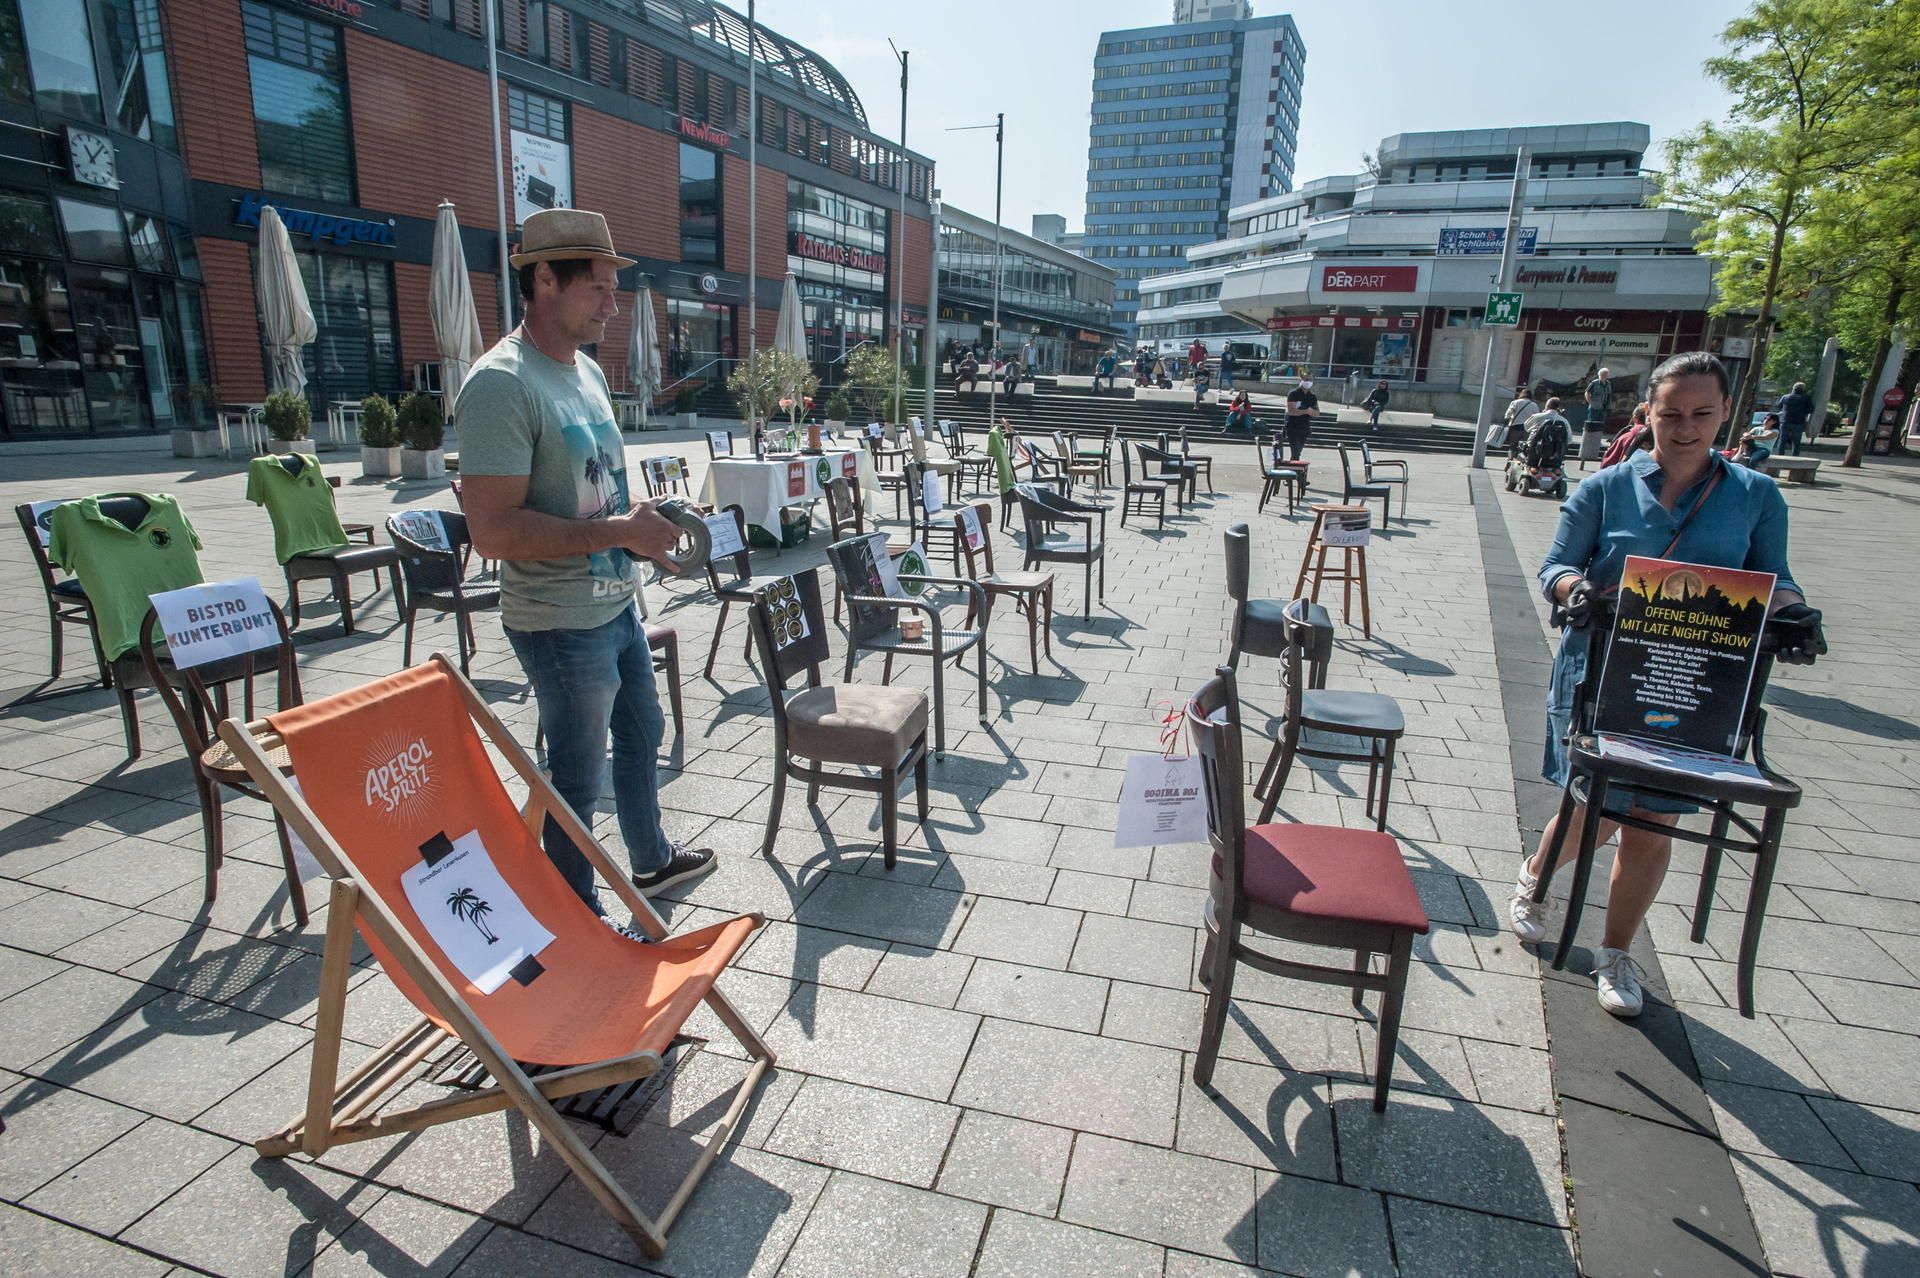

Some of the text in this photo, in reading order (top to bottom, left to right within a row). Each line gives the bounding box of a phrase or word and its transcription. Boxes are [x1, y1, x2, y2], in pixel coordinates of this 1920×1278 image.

[1459, 231, 1486, 239] Schuh
[1328, 271, 1387, 287] DERPART
[1516, 265, 1617, 288] Currywurst & Pommes
[1574, 315, 1612, 331] Curry
[1545, 338, 1649, 349] Currywurst Pommes
[187, 598, 246, 623] BISTRO
[1645, 606, 1732, 629] OFFENE BÜHNE
[167, 612, 272, 648] KUNTERBUNT
[1620, 618, 1752, 648] MIT LATE NIGHT SHOW
[366, 737, 433, 806] APEROL
